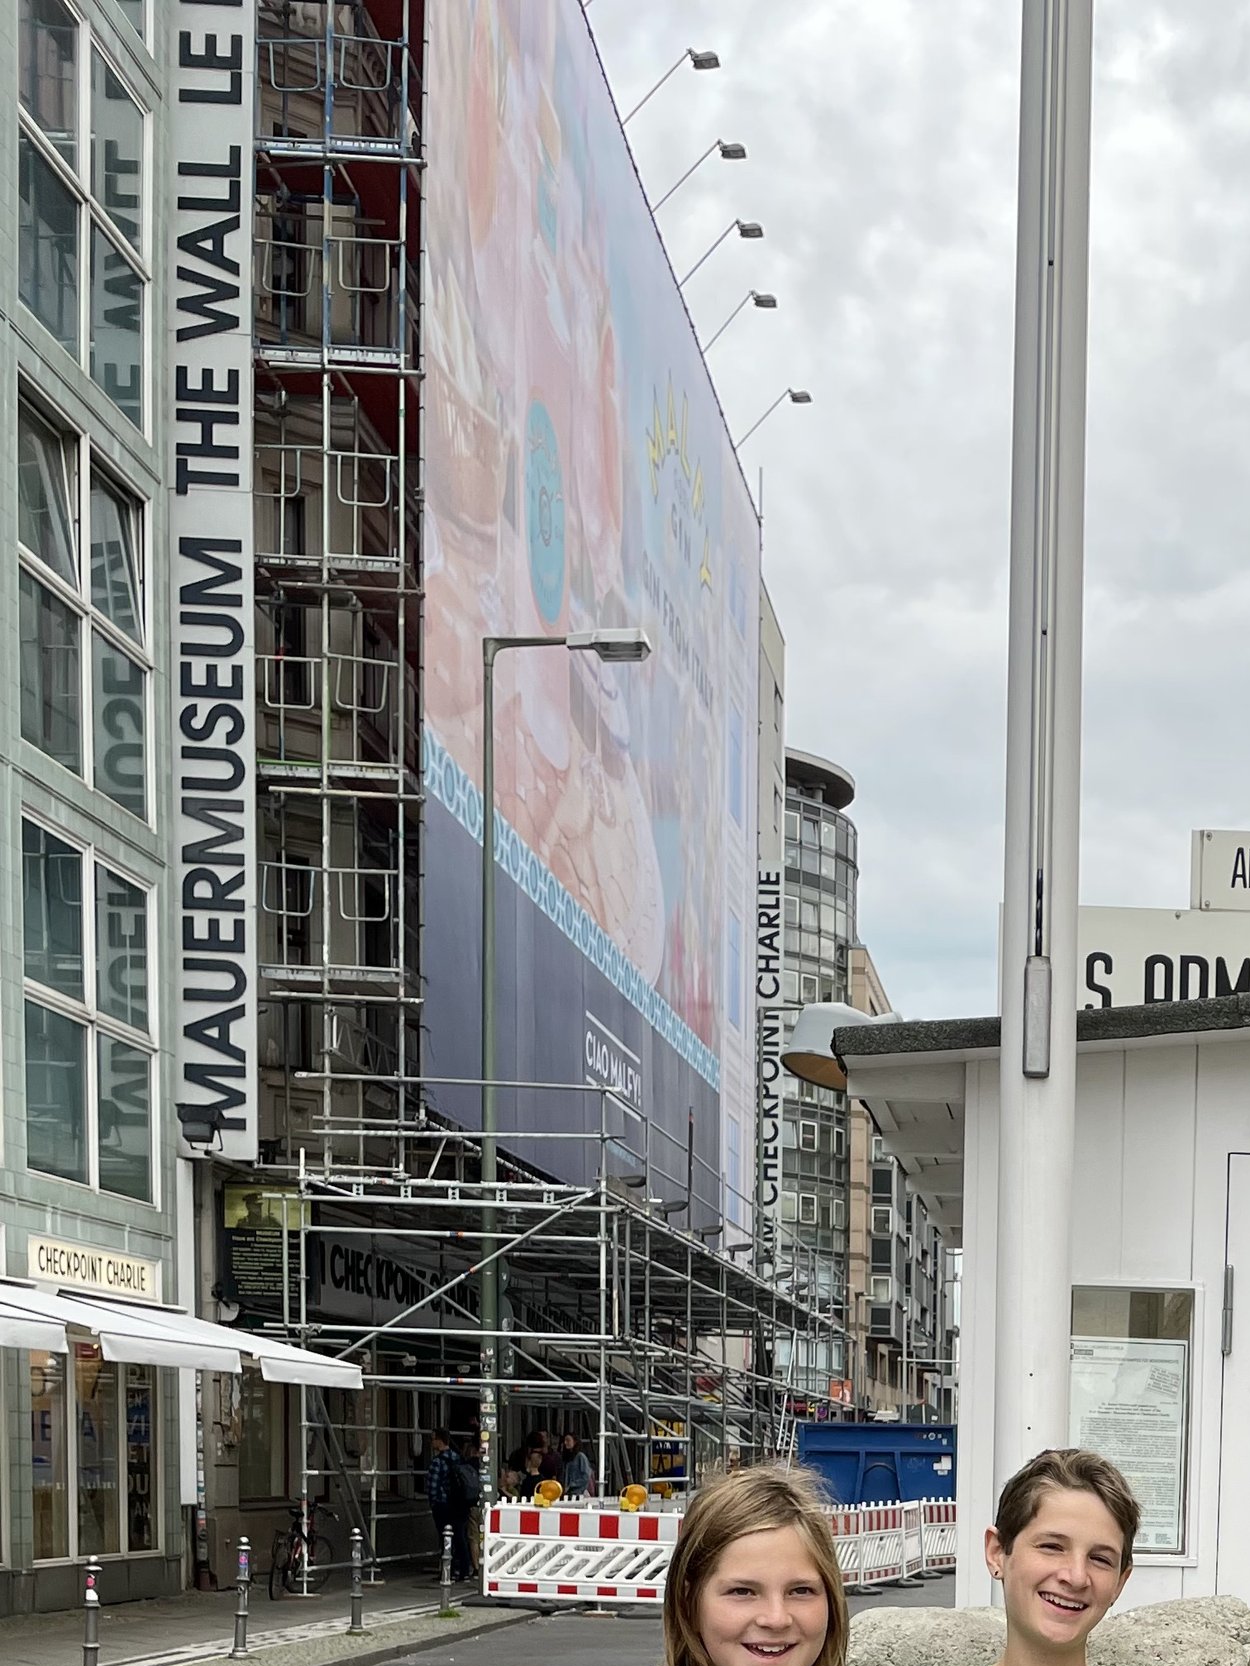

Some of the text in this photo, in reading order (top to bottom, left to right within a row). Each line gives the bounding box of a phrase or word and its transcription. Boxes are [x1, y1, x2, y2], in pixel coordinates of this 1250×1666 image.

[175, 144, 243, 343] WALL
[175, 364, 241, 496] THE
[179, 536, 249, 1132] MAUERMUSEUM
[756, 870, 780, 1000] CHARLIE
[585, 1030, 642, 1107] CIAO MALFY!
[38, 1244, 146, 1292] CHECKPOINT CHARLIE
